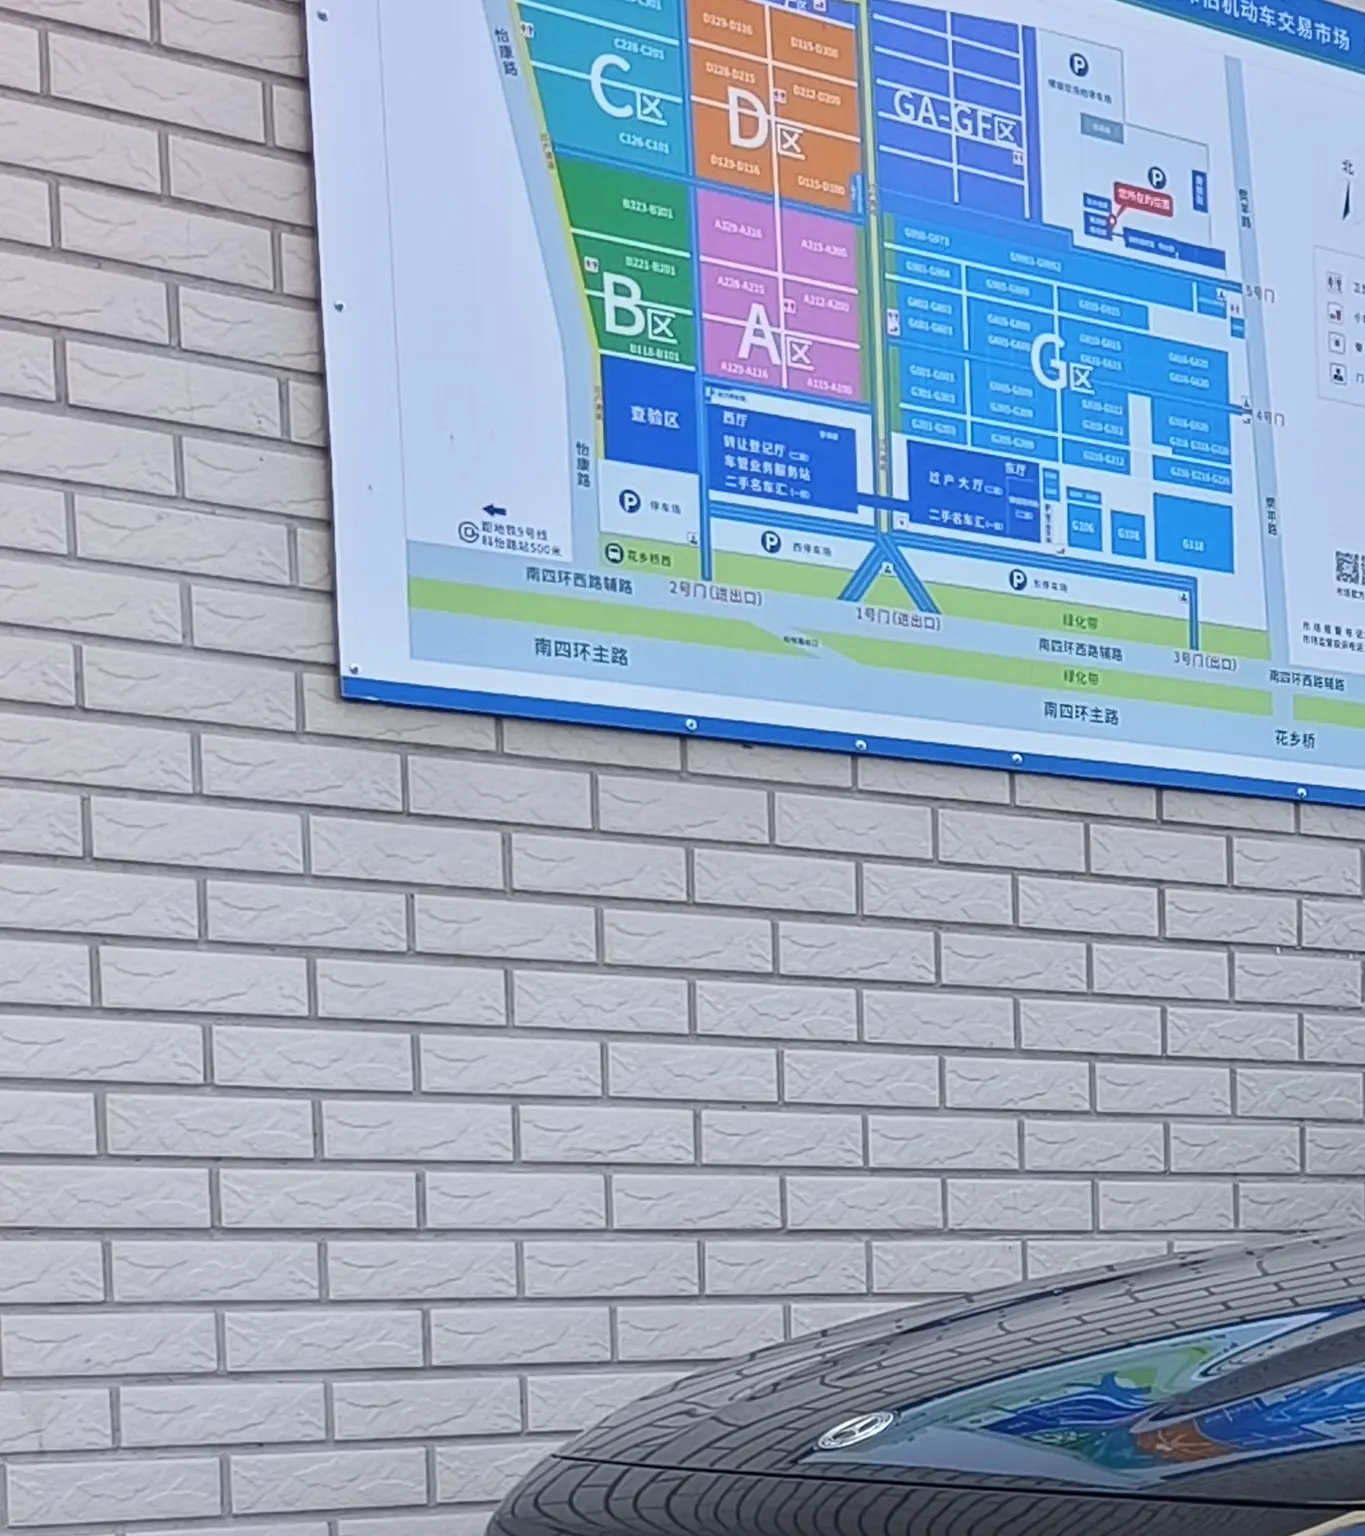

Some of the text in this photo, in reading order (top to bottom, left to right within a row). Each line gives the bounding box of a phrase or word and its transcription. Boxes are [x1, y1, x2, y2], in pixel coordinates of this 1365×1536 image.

[591, 54, 668, 126] C区
[728, 86, 806, 160] D区
[894, 88, 1018, 151] GA-GF区
[1341, 159, 1354, 176] 北
[603, 271, 678, 345] B区
[737, 303, 816, 372] A区
[1031, 333, 1096, 395] G区
[631, 405, 681, 429] 查验区
[723, 410, 748, 428] 西厅
[526, 566, 634, 596] 南四环西路辅路
[535, 637, 630, 667] 南四环主路
[1038, 637, 1123, 663] 南四环西路辅路
[1044, 701, 1120, 727] 南四环主路
[1275, 729, 1316, 750] 花乡桥
